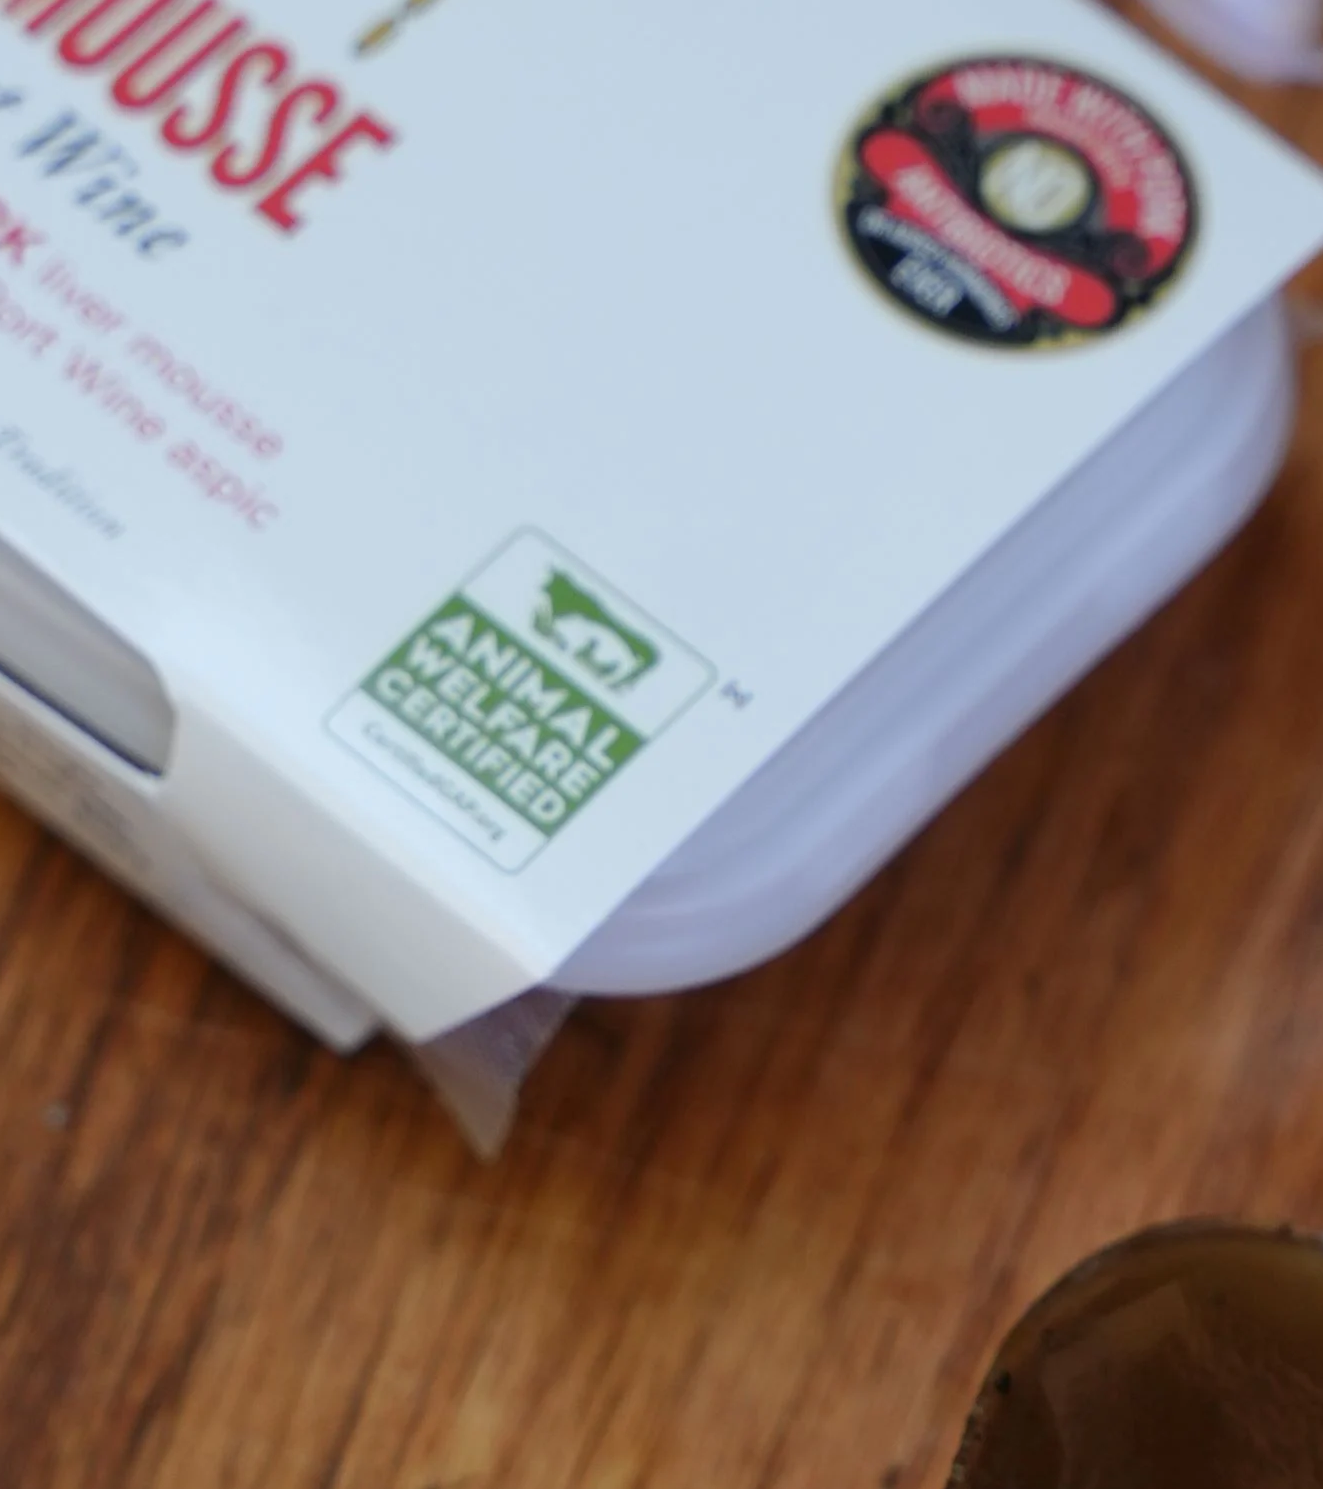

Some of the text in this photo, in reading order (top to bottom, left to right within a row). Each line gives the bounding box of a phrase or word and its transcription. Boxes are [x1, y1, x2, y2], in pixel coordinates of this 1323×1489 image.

[19, 111, 187, 256] Wine
[39, 262, 132, 341] liver
[120, 337, 291, 469] mousse
[64, 353, 165, 440] Wine
[166, 441, 277, 529] aspic
[368, 661, 570, 828] CERTIFIED
[400, 633, 601, 803] WELFARE
[424, 606, 625, 771] ANIMAL
